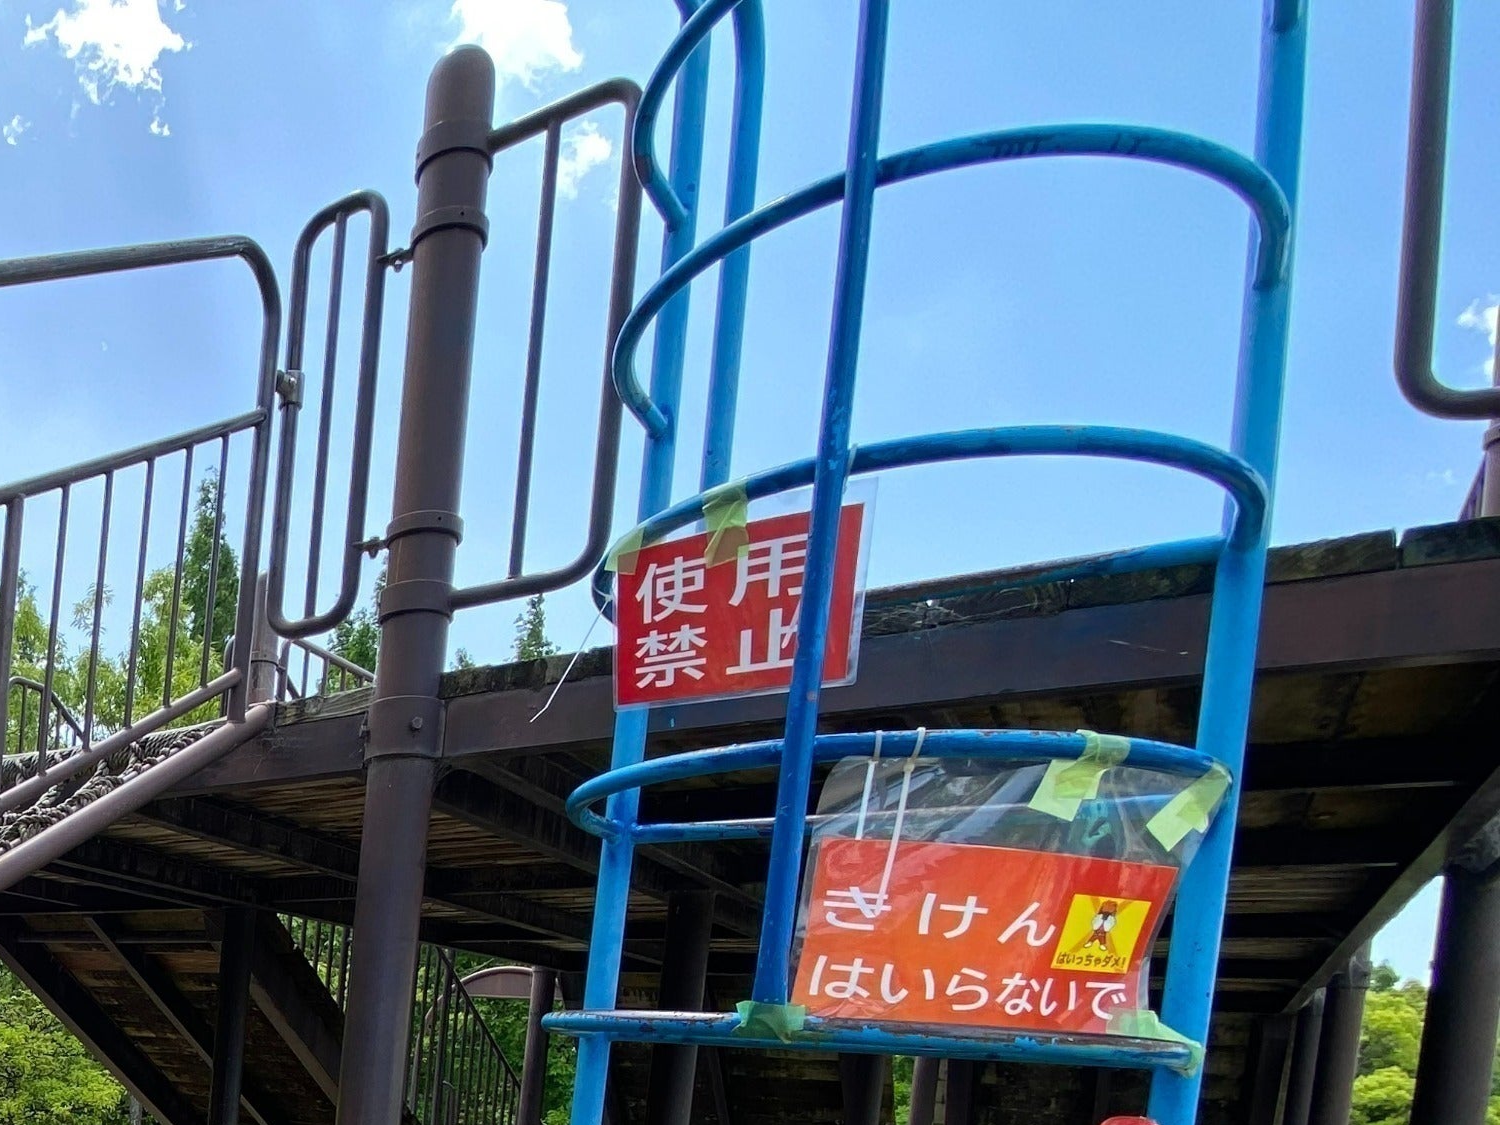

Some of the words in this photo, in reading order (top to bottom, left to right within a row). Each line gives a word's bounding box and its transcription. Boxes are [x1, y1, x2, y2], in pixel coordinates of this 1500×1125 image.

[635, 532, 808, 625] 使用
[635, 607, 799, 689] 禁止
[823, 886, 1056, 947] きけん
[809, 955, 1127, 1020] はいらないで
